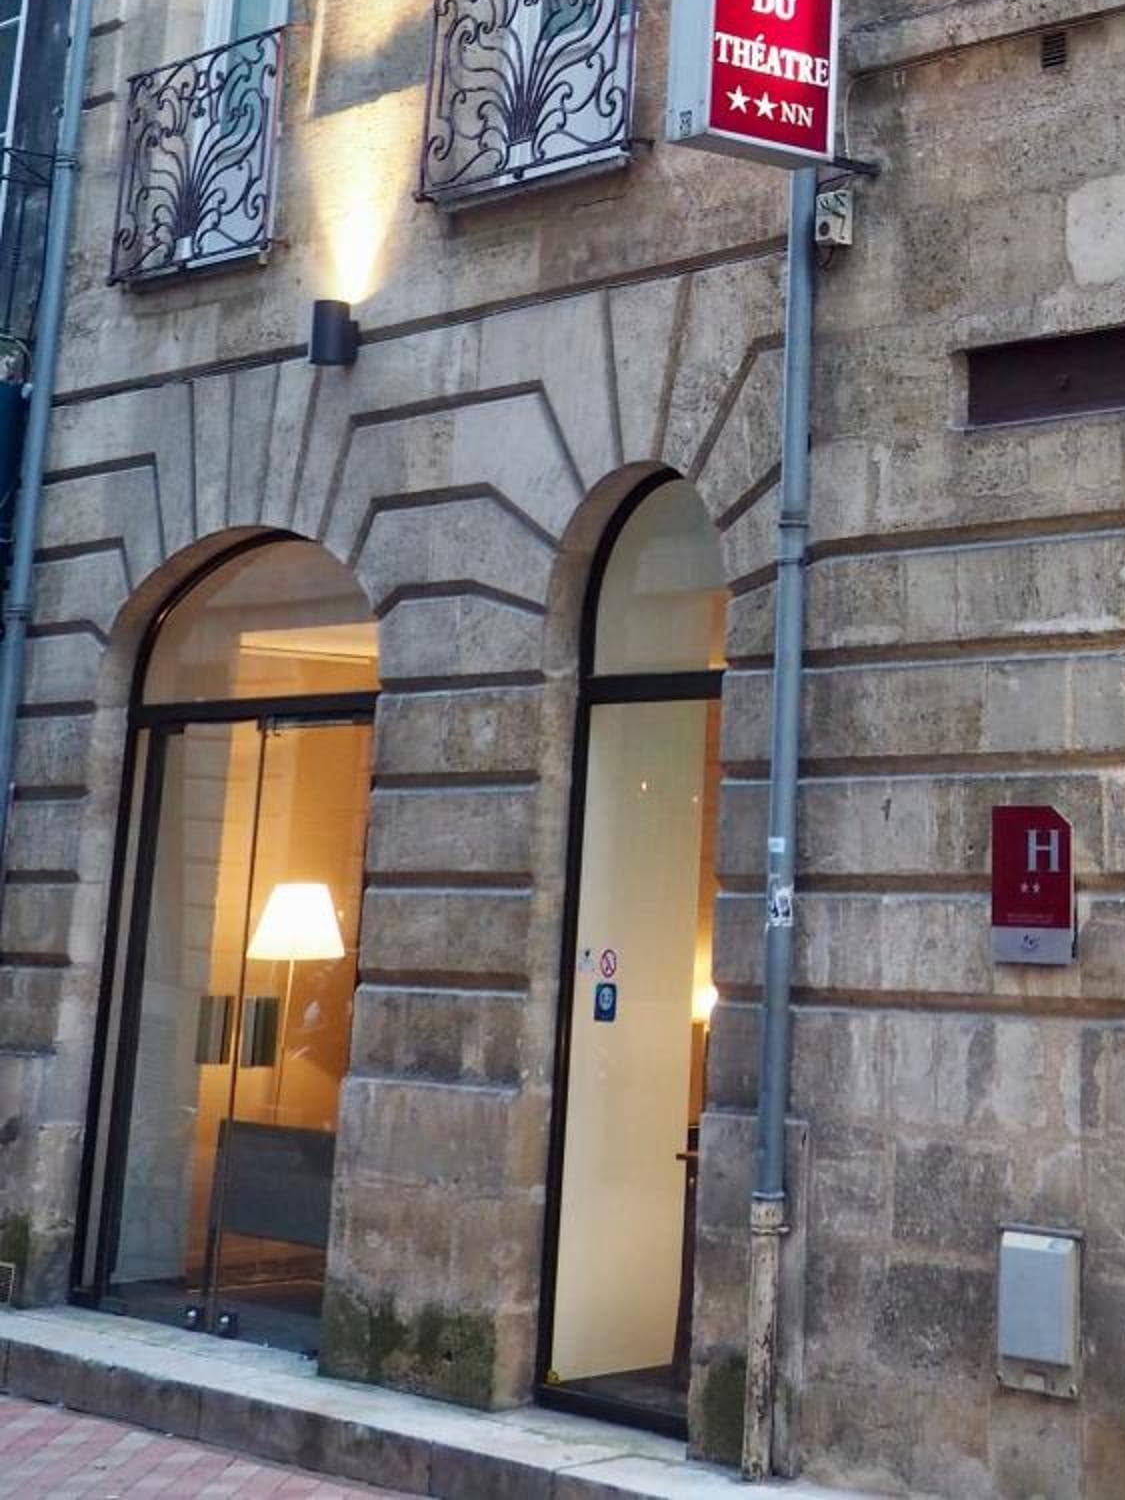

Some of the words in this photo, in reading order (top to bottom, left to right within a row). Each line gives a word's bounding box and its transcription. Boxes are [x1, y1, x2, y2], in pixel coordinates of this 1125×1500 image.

[715, 31, 829, 88] THÉATRE
[780, 100, 814, 128] NN
[1026, 829, 1060, 872] H
